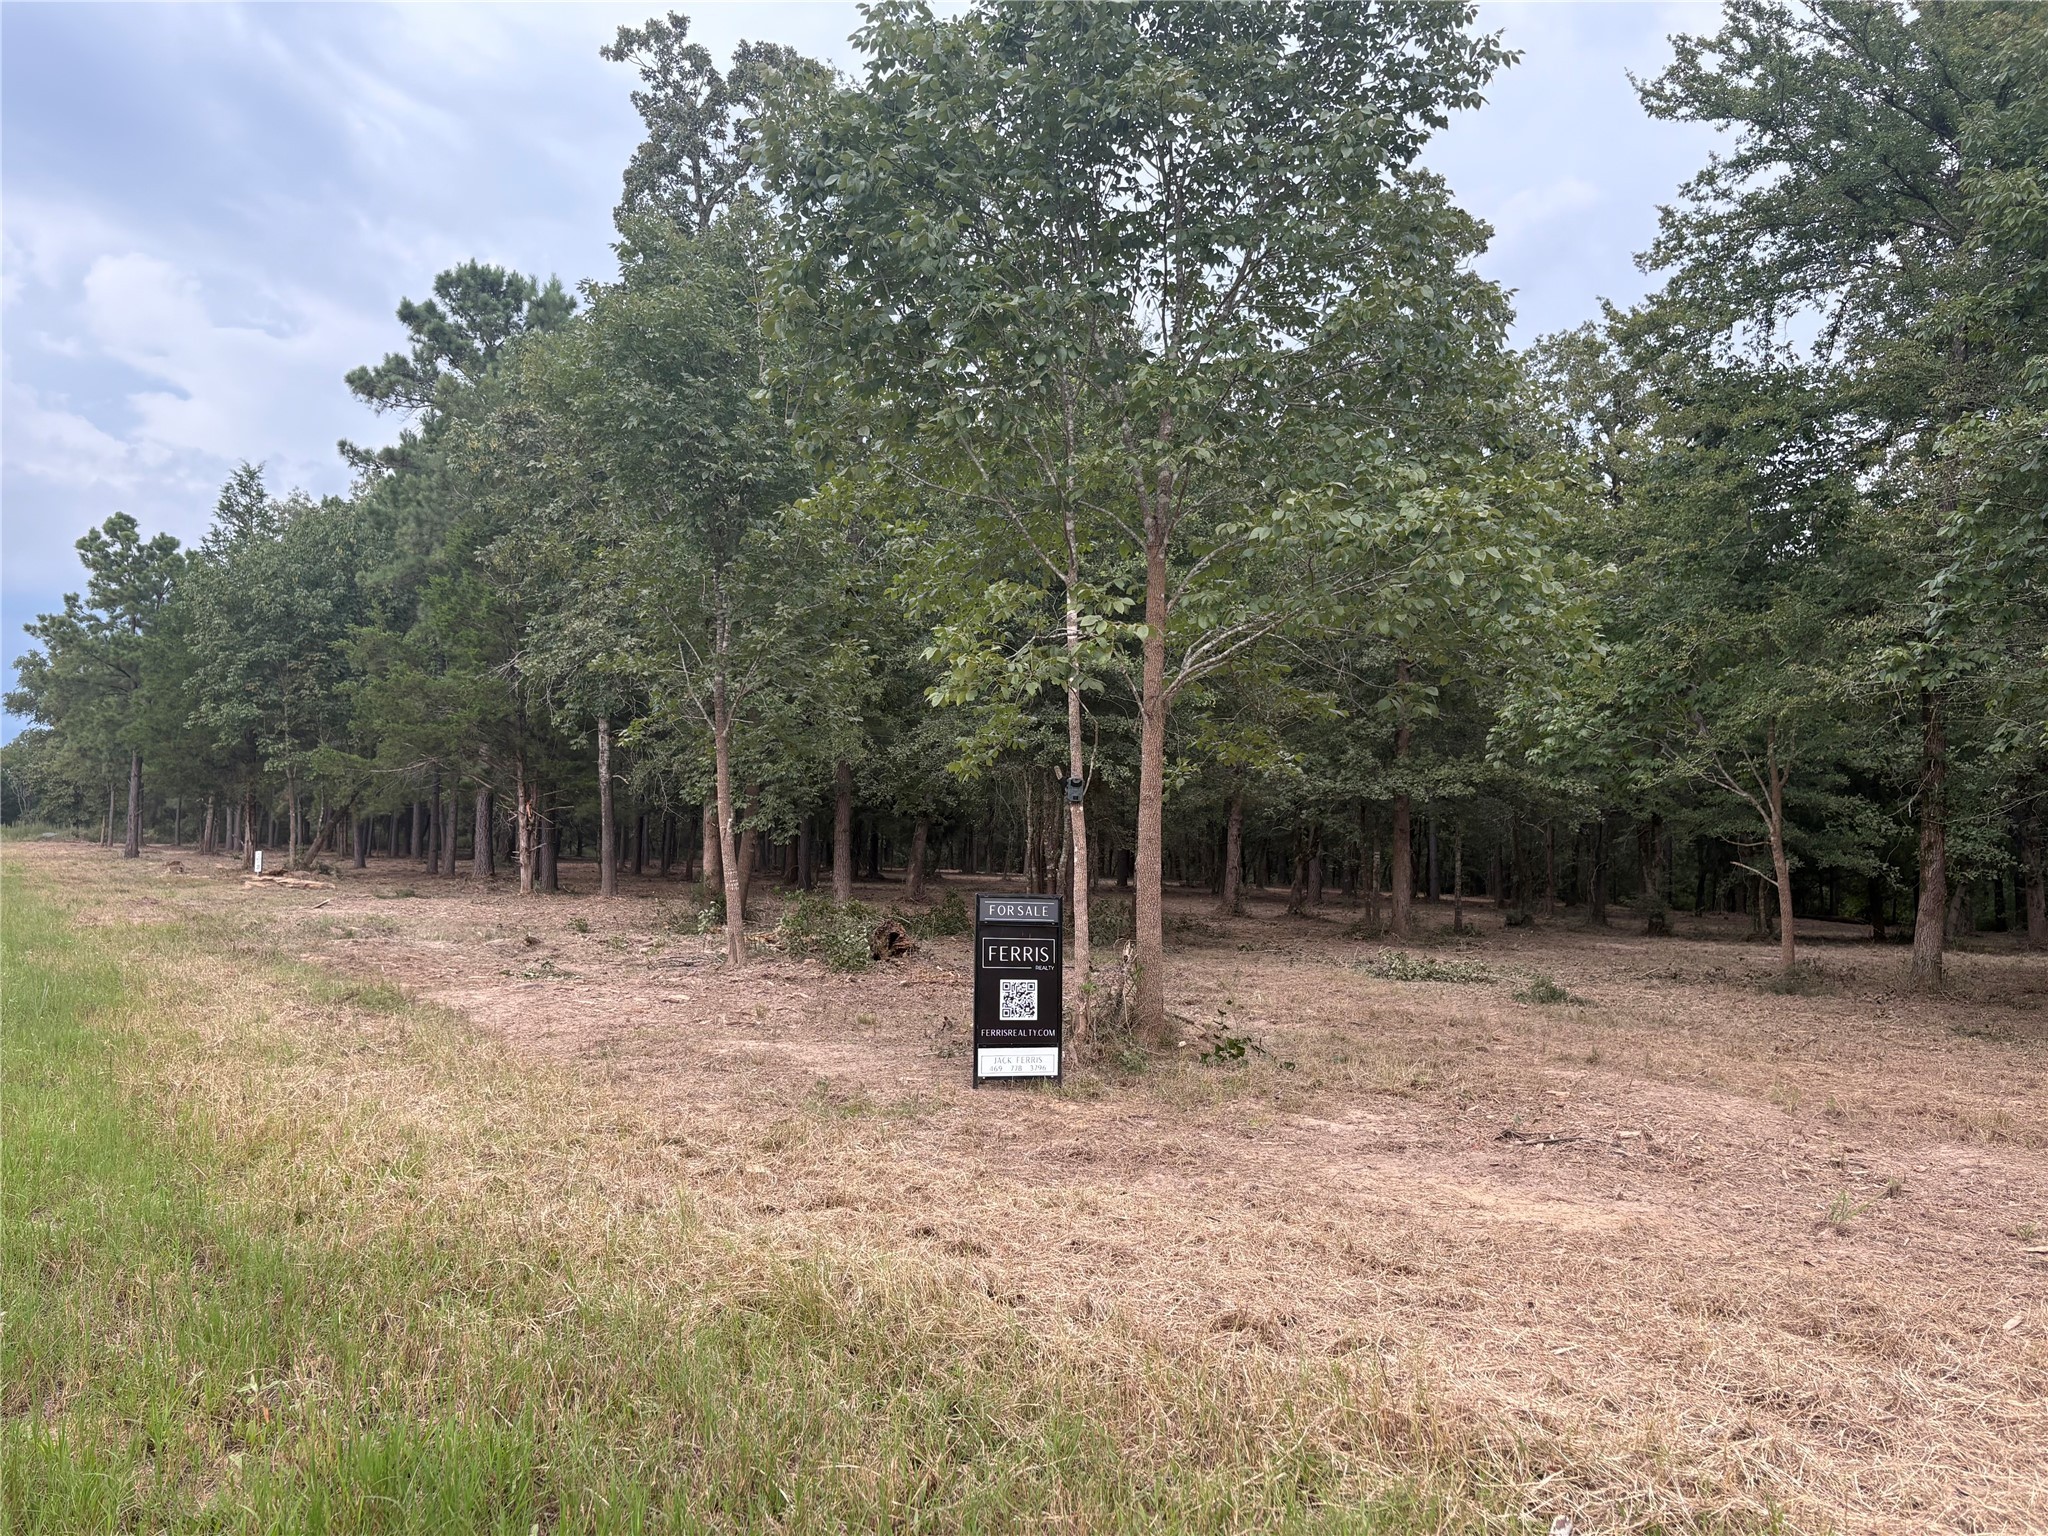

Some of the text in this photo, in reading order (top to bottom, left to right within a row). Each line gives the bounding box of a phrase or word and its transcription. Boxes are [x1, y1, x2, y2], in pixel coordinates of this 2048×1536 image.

[989, 904, 1049, 917] FOR SALE
[988, 945, 1049, 962] FERRIS
[981, 1028, 1056, 1037] FERRISREALTY.COM
[994, 1056, 1043, 1065] JACK FERRIS
